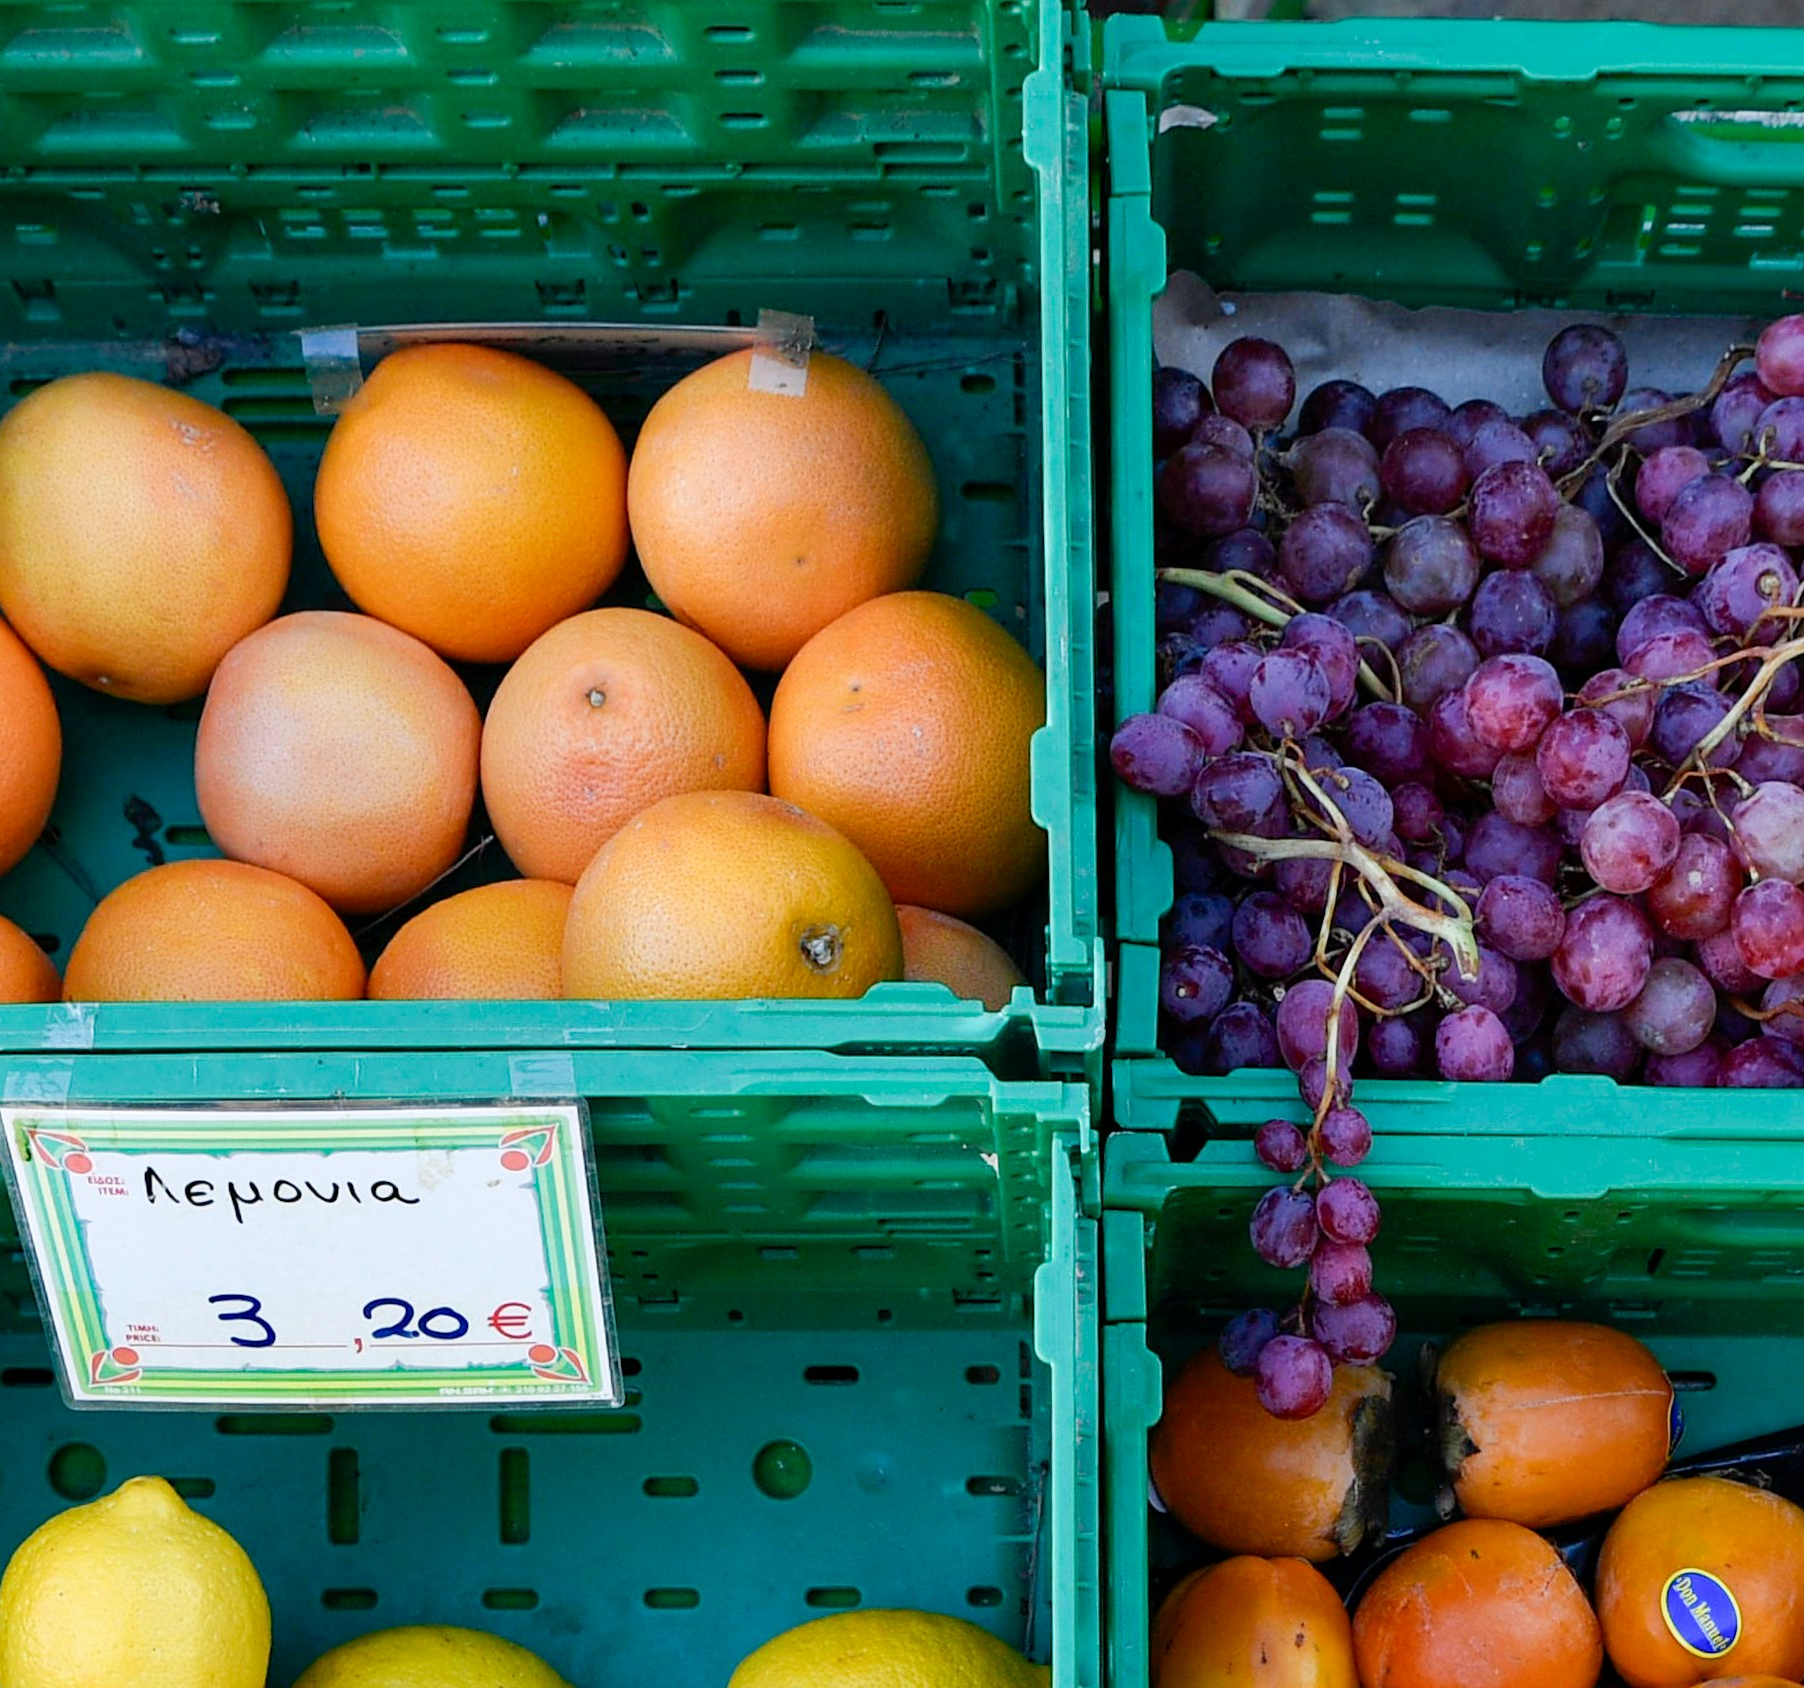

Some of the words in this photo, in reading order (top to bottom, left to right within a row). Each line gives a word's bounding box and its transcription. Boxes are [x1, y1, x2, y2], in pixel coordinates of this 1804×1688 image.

[208, 1293, 276, 1348] 3
[486, 1301, 533, 1340] €
[1672, 1576, 1698, 1608] Don
[1689, 1601, 1730, 1652] Manuel
